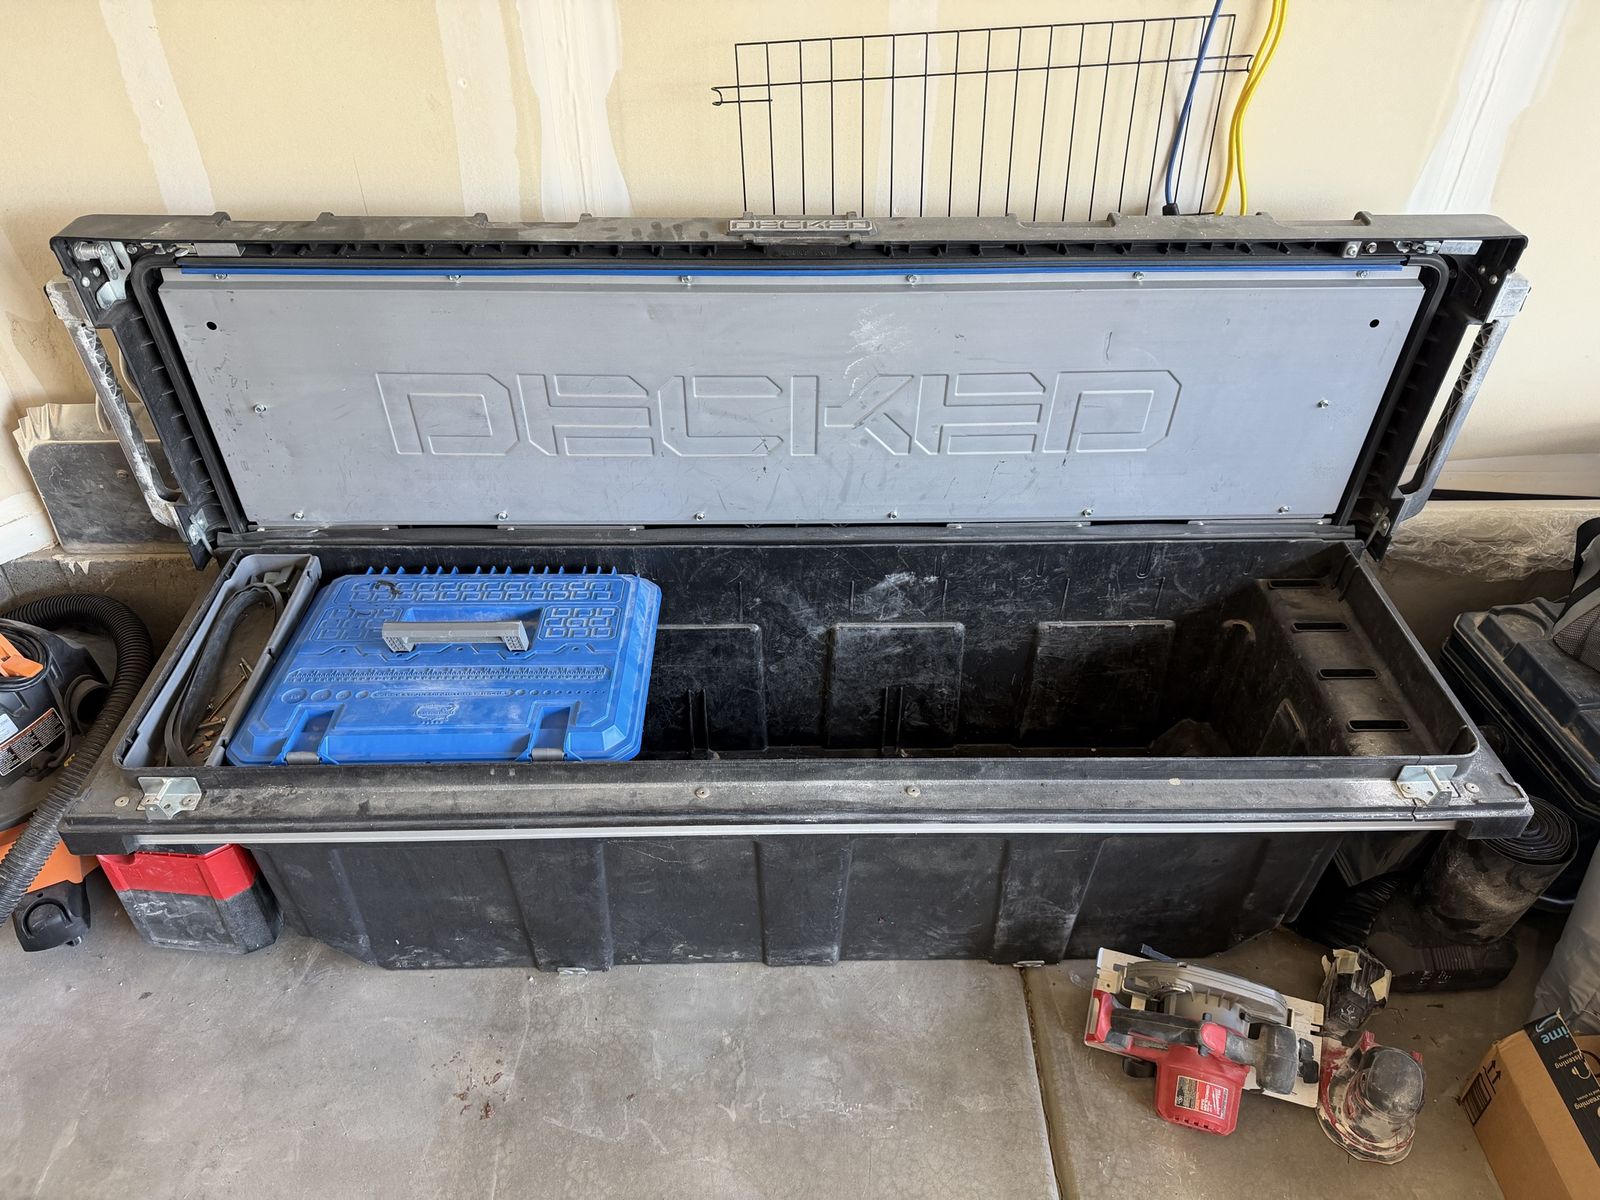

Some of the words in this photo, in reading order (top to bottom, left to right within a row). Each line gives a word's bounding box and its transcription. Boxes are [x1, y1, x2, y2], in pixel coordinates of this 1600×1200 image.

[731, 219, 872, 231] DECKED
[375, 369, 1182, 457] DECKED
[1541, 1026, 1569, 1044] ime
